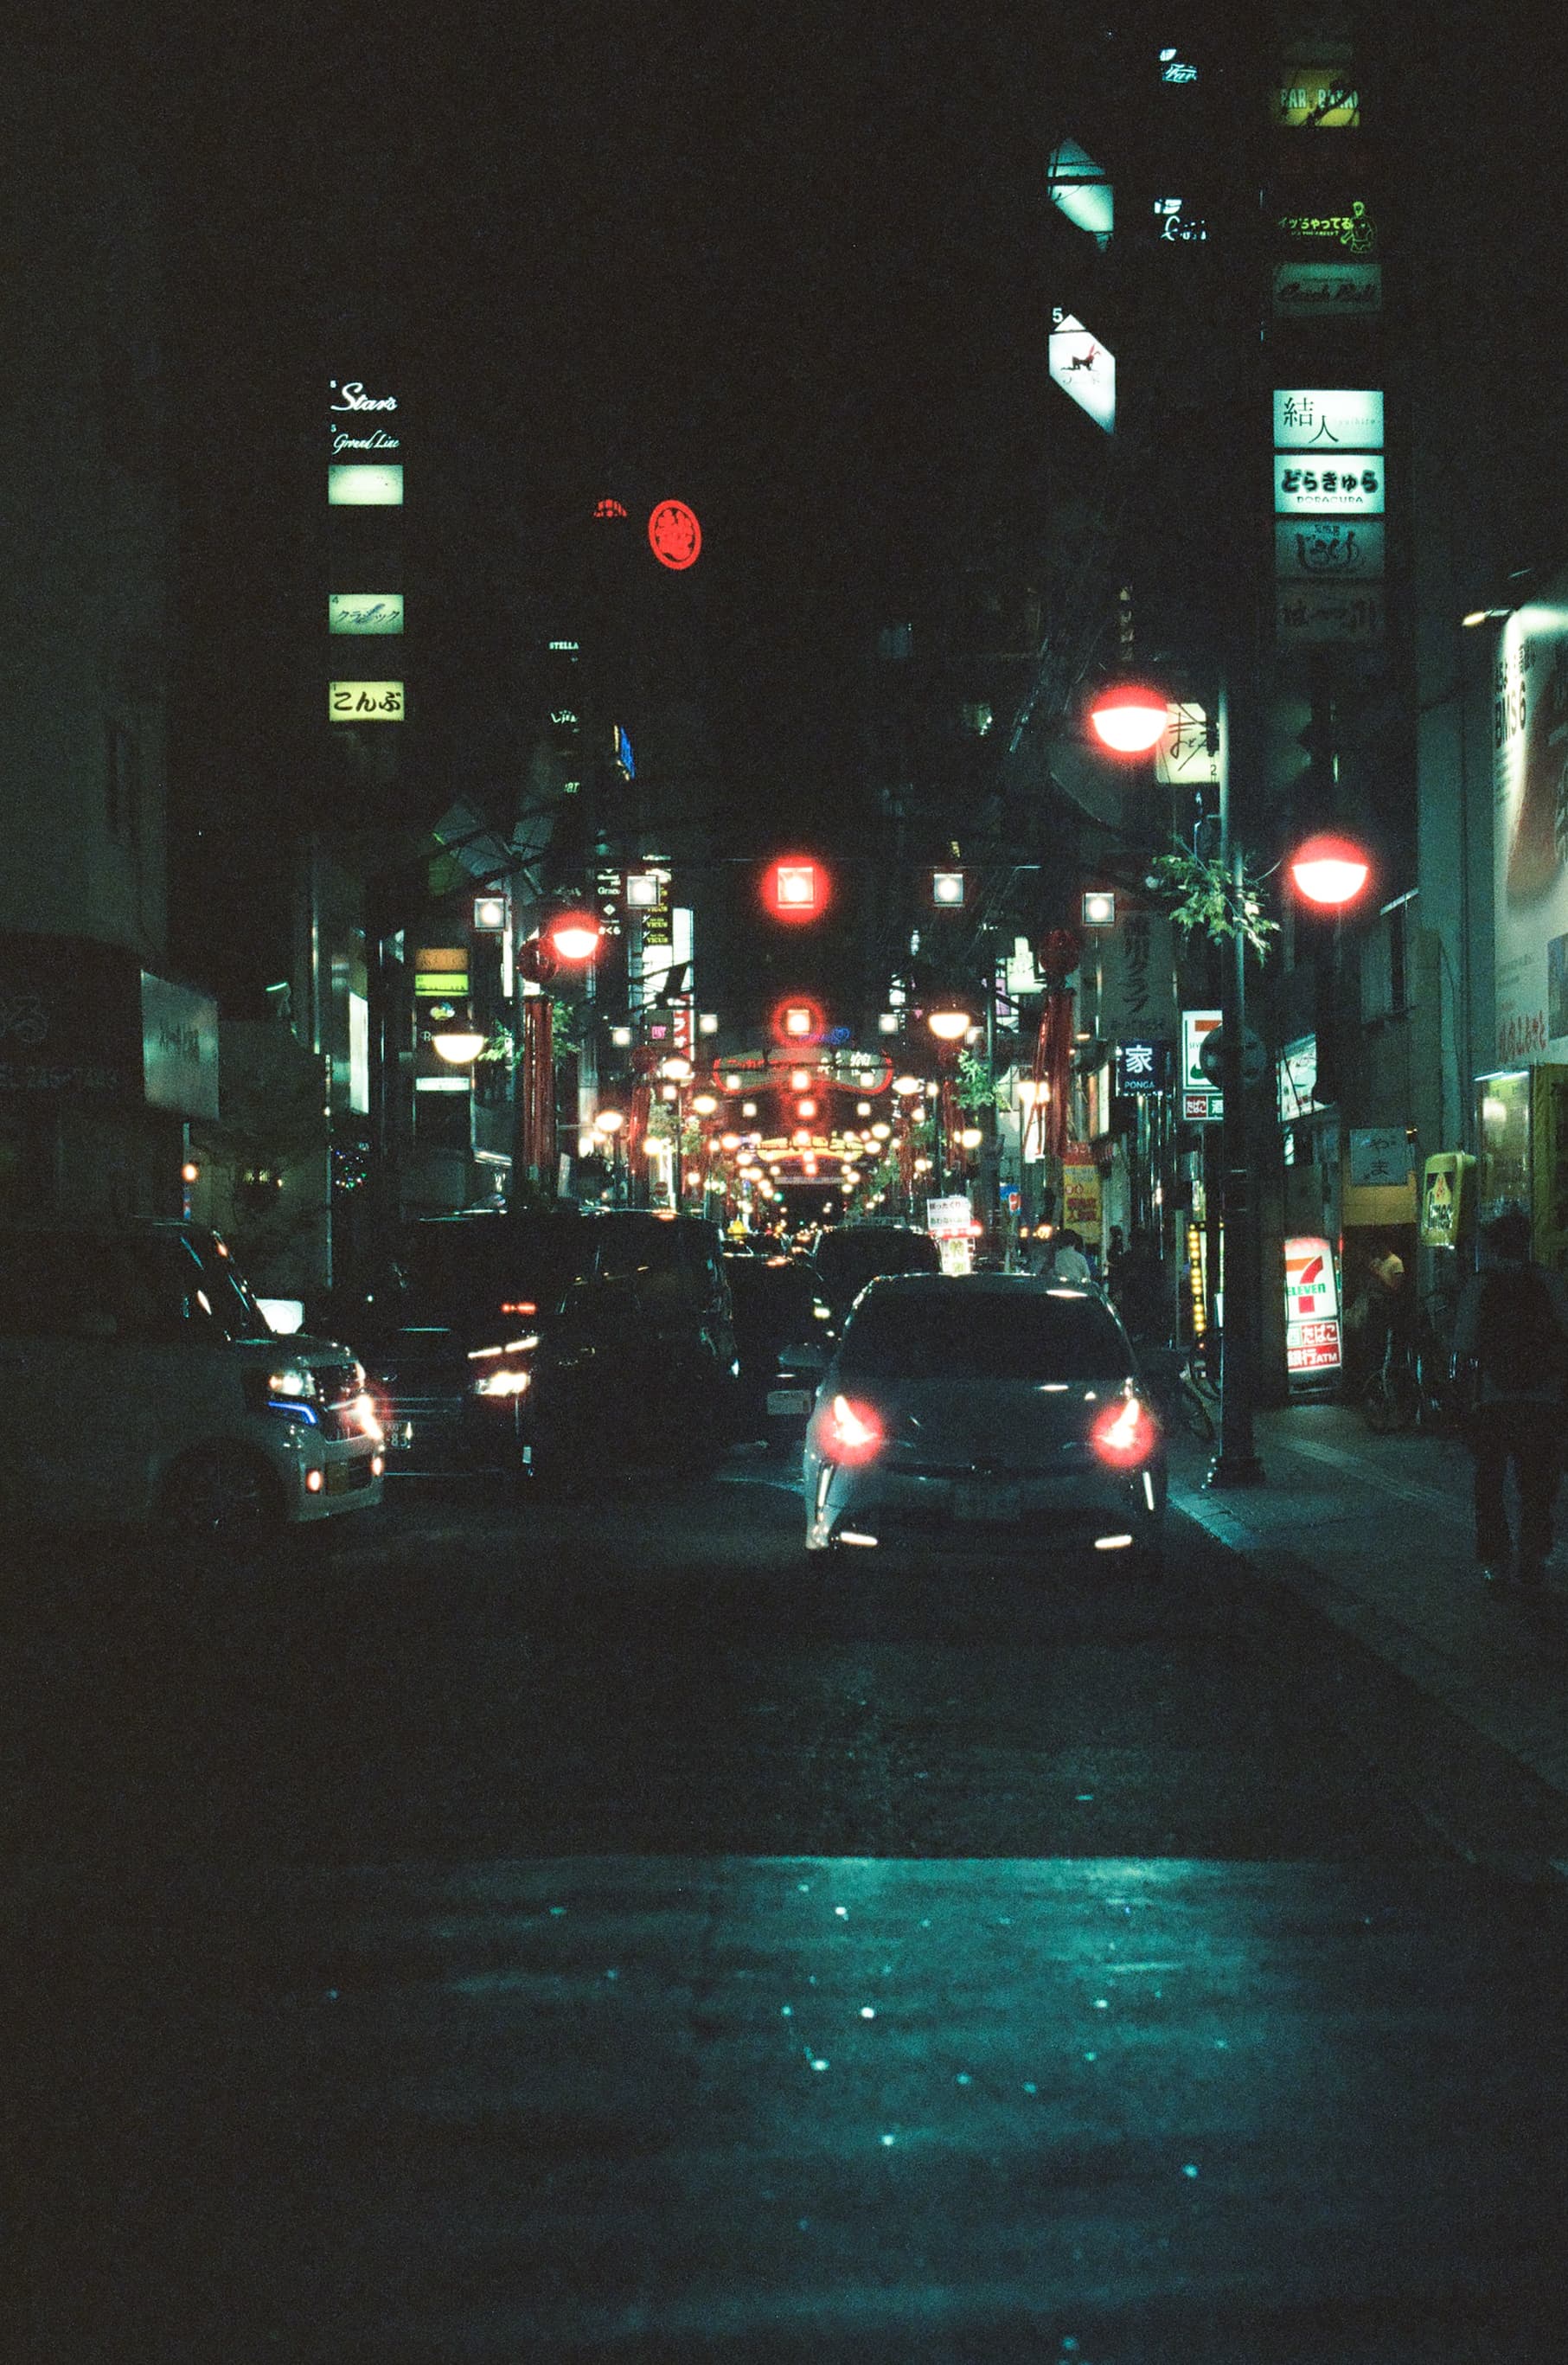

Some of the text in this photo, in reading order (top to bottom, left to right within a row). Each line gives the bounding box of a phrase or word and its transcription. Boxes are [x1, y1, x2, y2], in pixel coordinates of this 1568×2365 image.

[1052, 307, 1063, 323] 5
[1283, 396, 1340, 444] 結人
[1281, 468, 1379, 494] どらきゅら
[334, 691, 401, 712] こんぶ
[1124, 1043, 1154, 1074] 家
[1124, 1080, 1155, 1090] PONGA
[1302, 1324, 1338, 1345] たばこ
